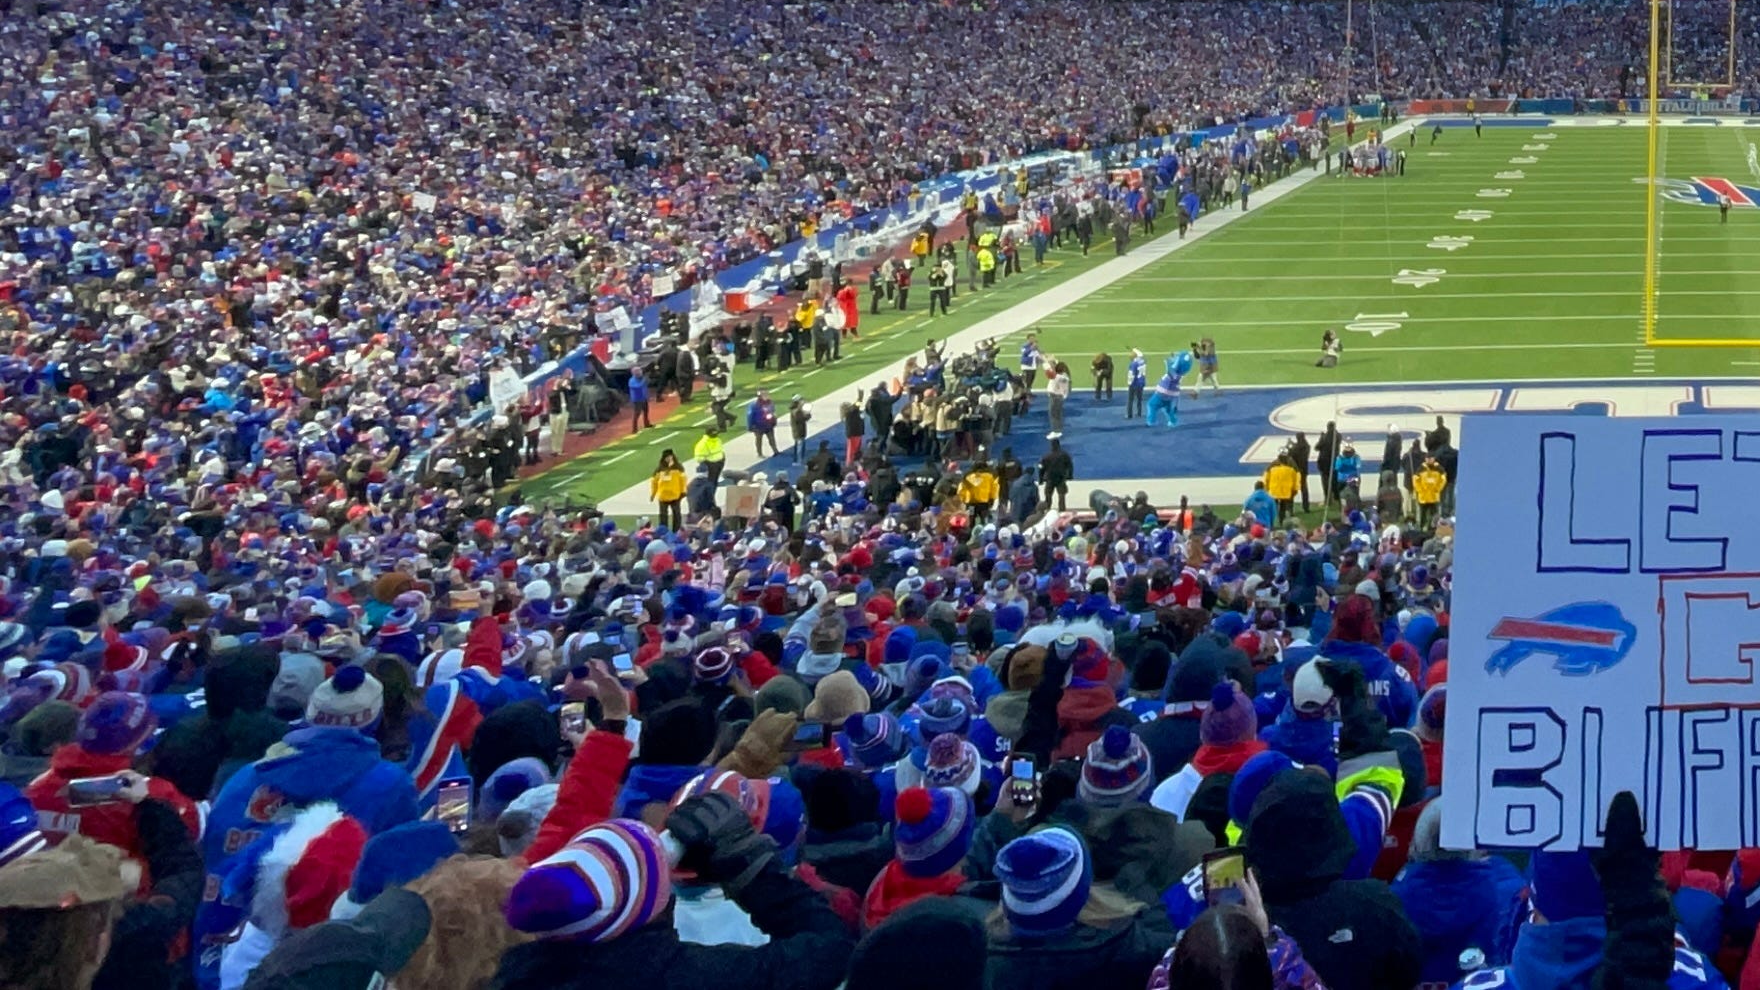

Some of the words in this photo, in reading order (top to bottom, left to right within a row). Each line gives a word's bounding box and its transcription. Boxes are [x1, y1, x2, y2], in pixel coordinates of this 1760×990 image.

[1640, 100, 1697, 112] BFFALO
[1391, 268, 1447, 284] 20
[1345, 312, 1409, 331] 10
